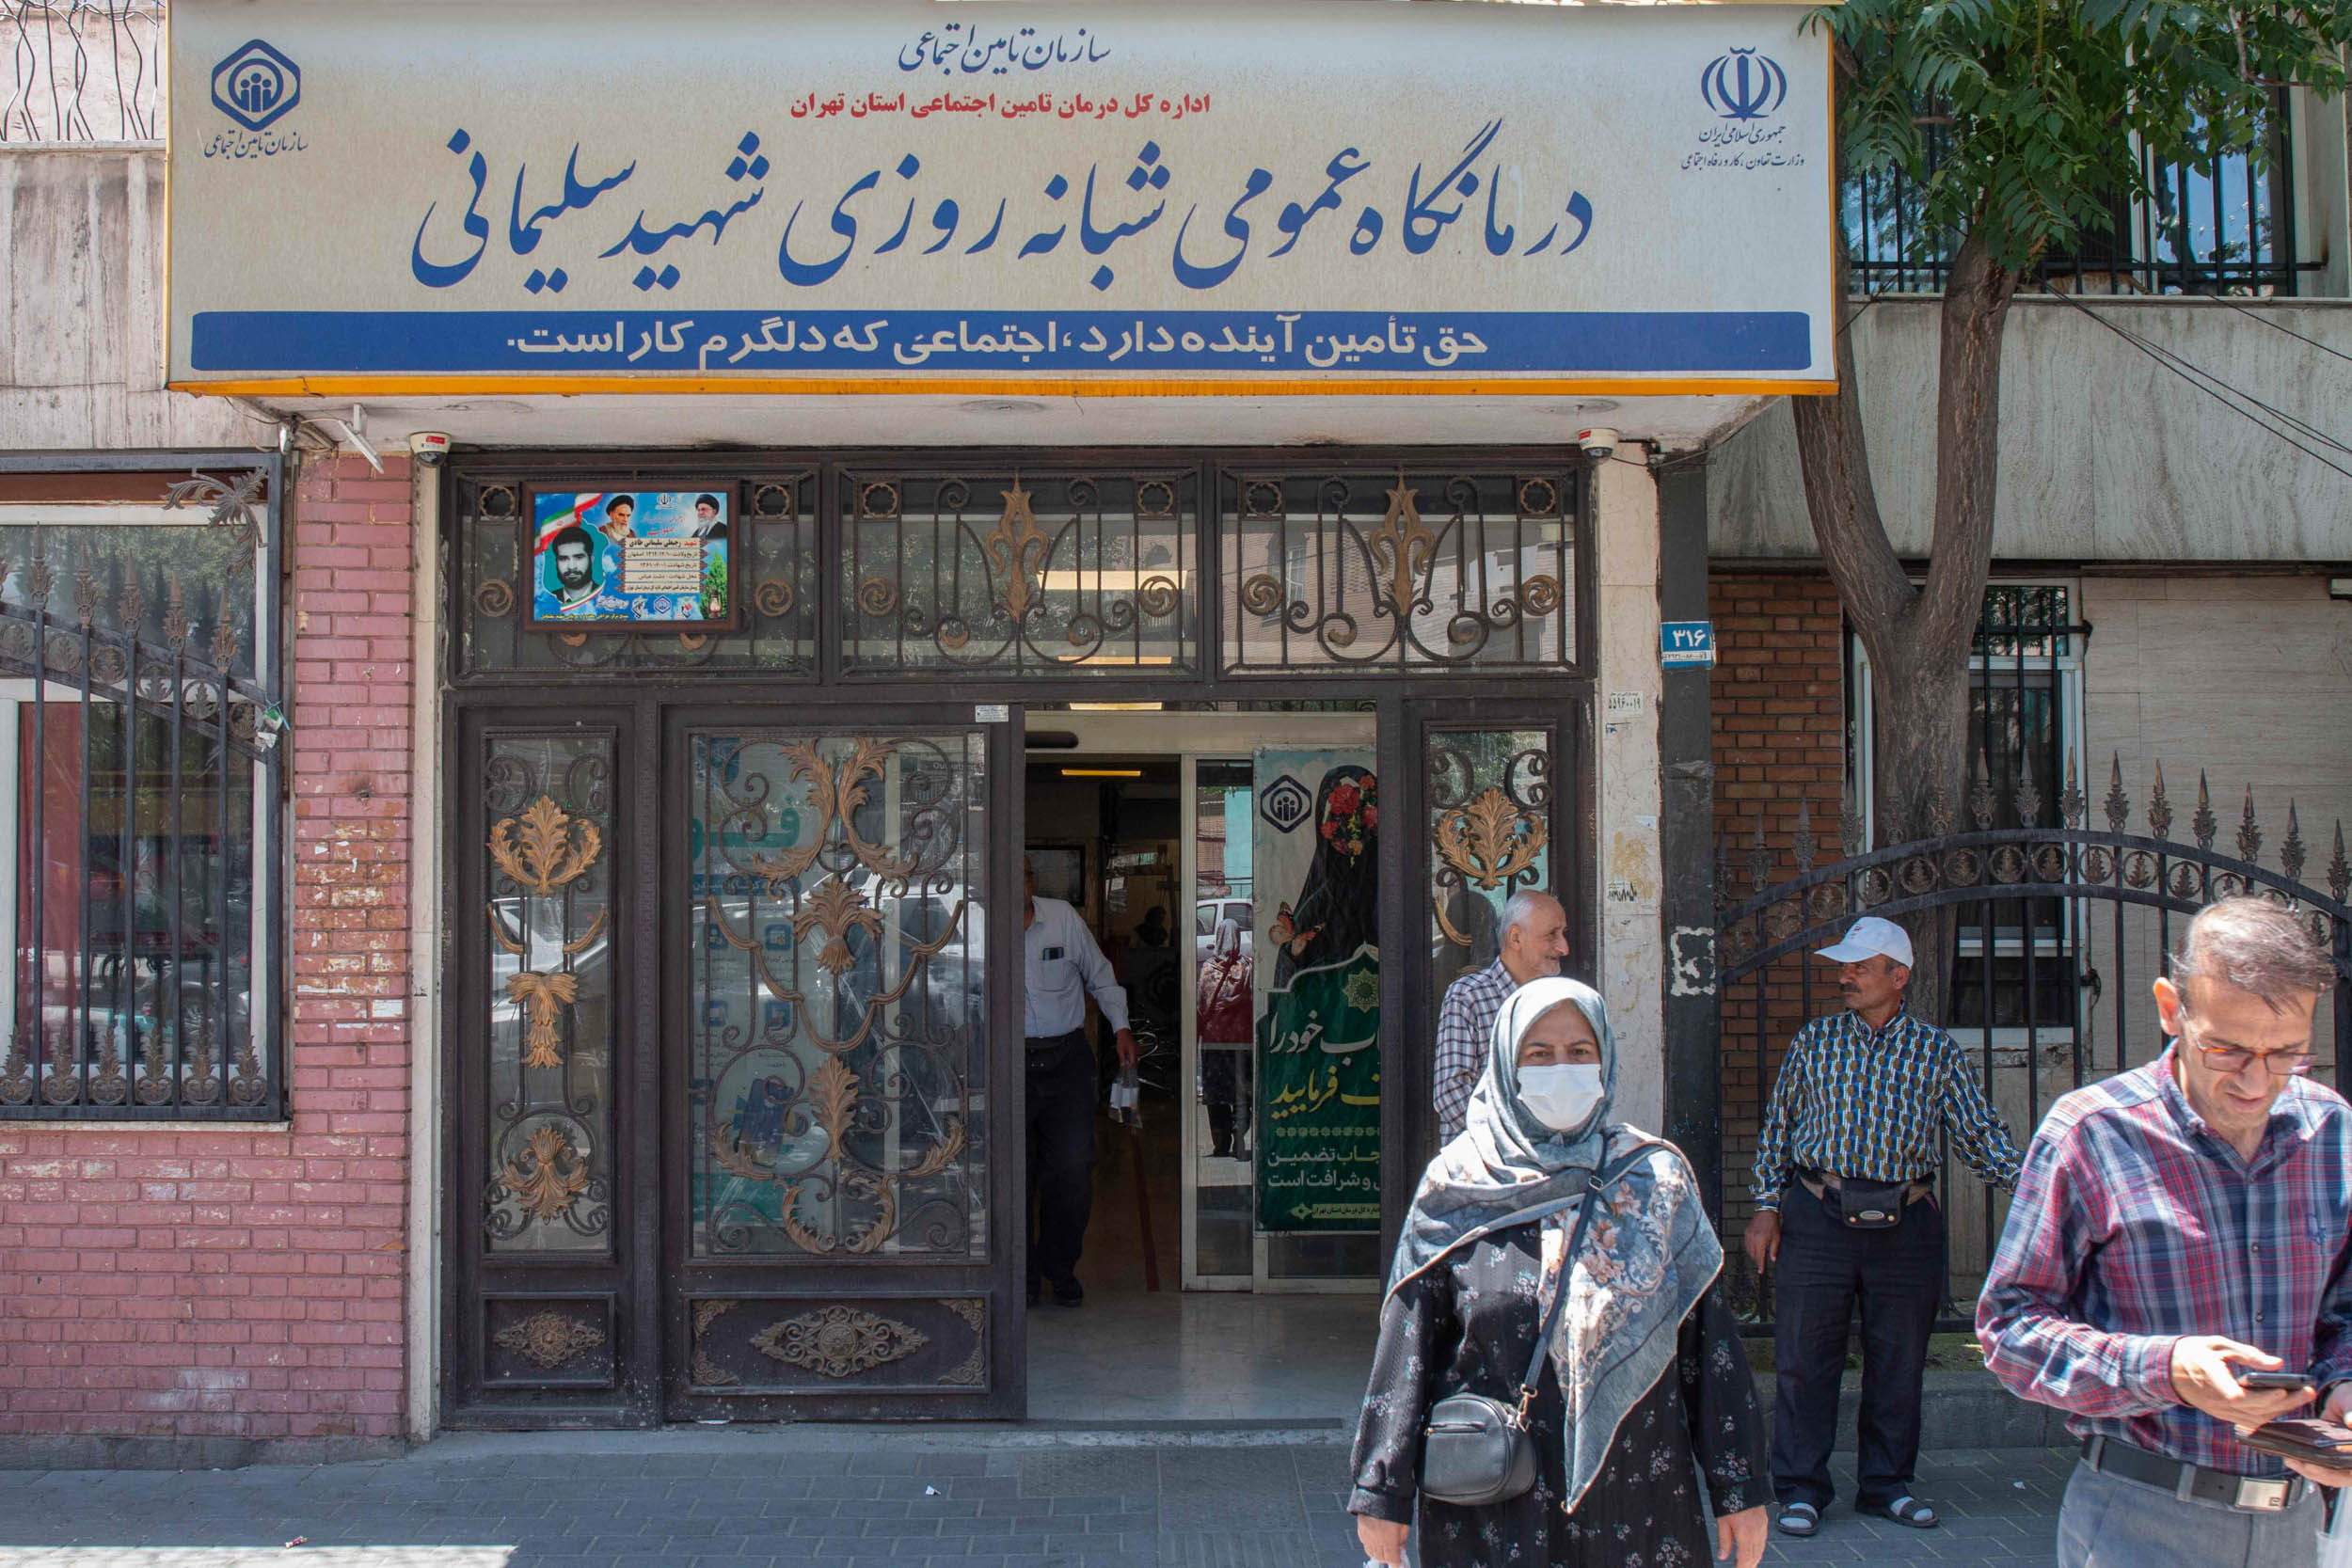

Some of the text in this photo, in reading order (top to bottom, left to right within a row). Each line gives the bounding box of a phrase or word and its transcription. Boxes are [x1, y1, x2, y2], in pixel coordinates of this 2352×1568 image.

[898, 23, 1111, 75] سازمان تامین اجتماعی
[790, 92, 1211, 119] اداره کل درمان تامین اجتماعی استان تهران
[203, 129, 310, 160] سازمان تامین اجتماعی
[1698, 122, 1787, 147] جمهوری اسلامی ایران
[1680, 151, 1707, 171] اجتماعی
[1707, 152, 1723, 166] رفاه
[1729, 150, 1744, 166] کار
[1771, 153, 1804, 166] وزارت
[1349, 118, 1595, 258] درمانگاه
[410, 127, 637, 295] سلیمانی
[597, 131, 771, 291] شهید
[1172, 147, 1371, 290] عمومی
[628, 320, 695, 362] کار
[698, 315, 828, 371] دلگرم
[833, 319, 889, 354] که
[893, 320, 1057, 366] اجتماعی
[1180, 313, 1302, 362] آینده
[1304, 316, 1417, 368] تأمین
[1422, 325, 1488, 367] حق
[1672, 628, 1707, 647] ۳۱۶
[1269, 1065, 1339, 1120] فرمایید
[1266, 1147, 1336, 1167] تضمین
[1267, 1169, 1304, 1187] است
[1306, 1169, 1360, 1192] شرافت
